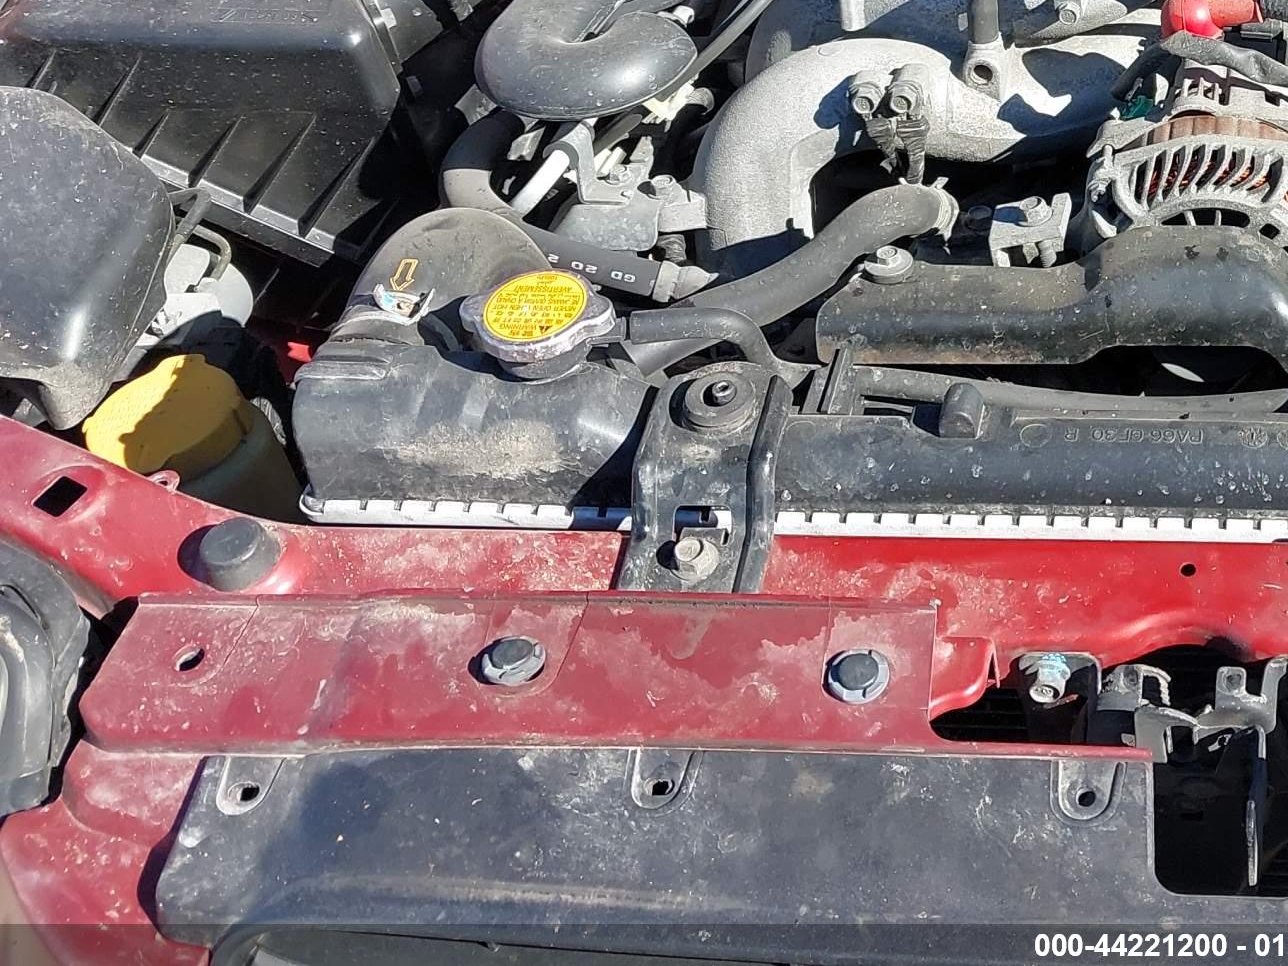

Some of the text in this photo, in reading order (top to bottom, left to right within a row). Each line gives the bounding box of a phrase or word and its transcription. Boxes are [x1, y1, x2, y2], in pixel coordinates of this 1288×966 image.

[571, 261, 598, 274] 20
[610, 270, 636, 283] GD
[512, 285, 573, 293] AVERTISSEMENT
